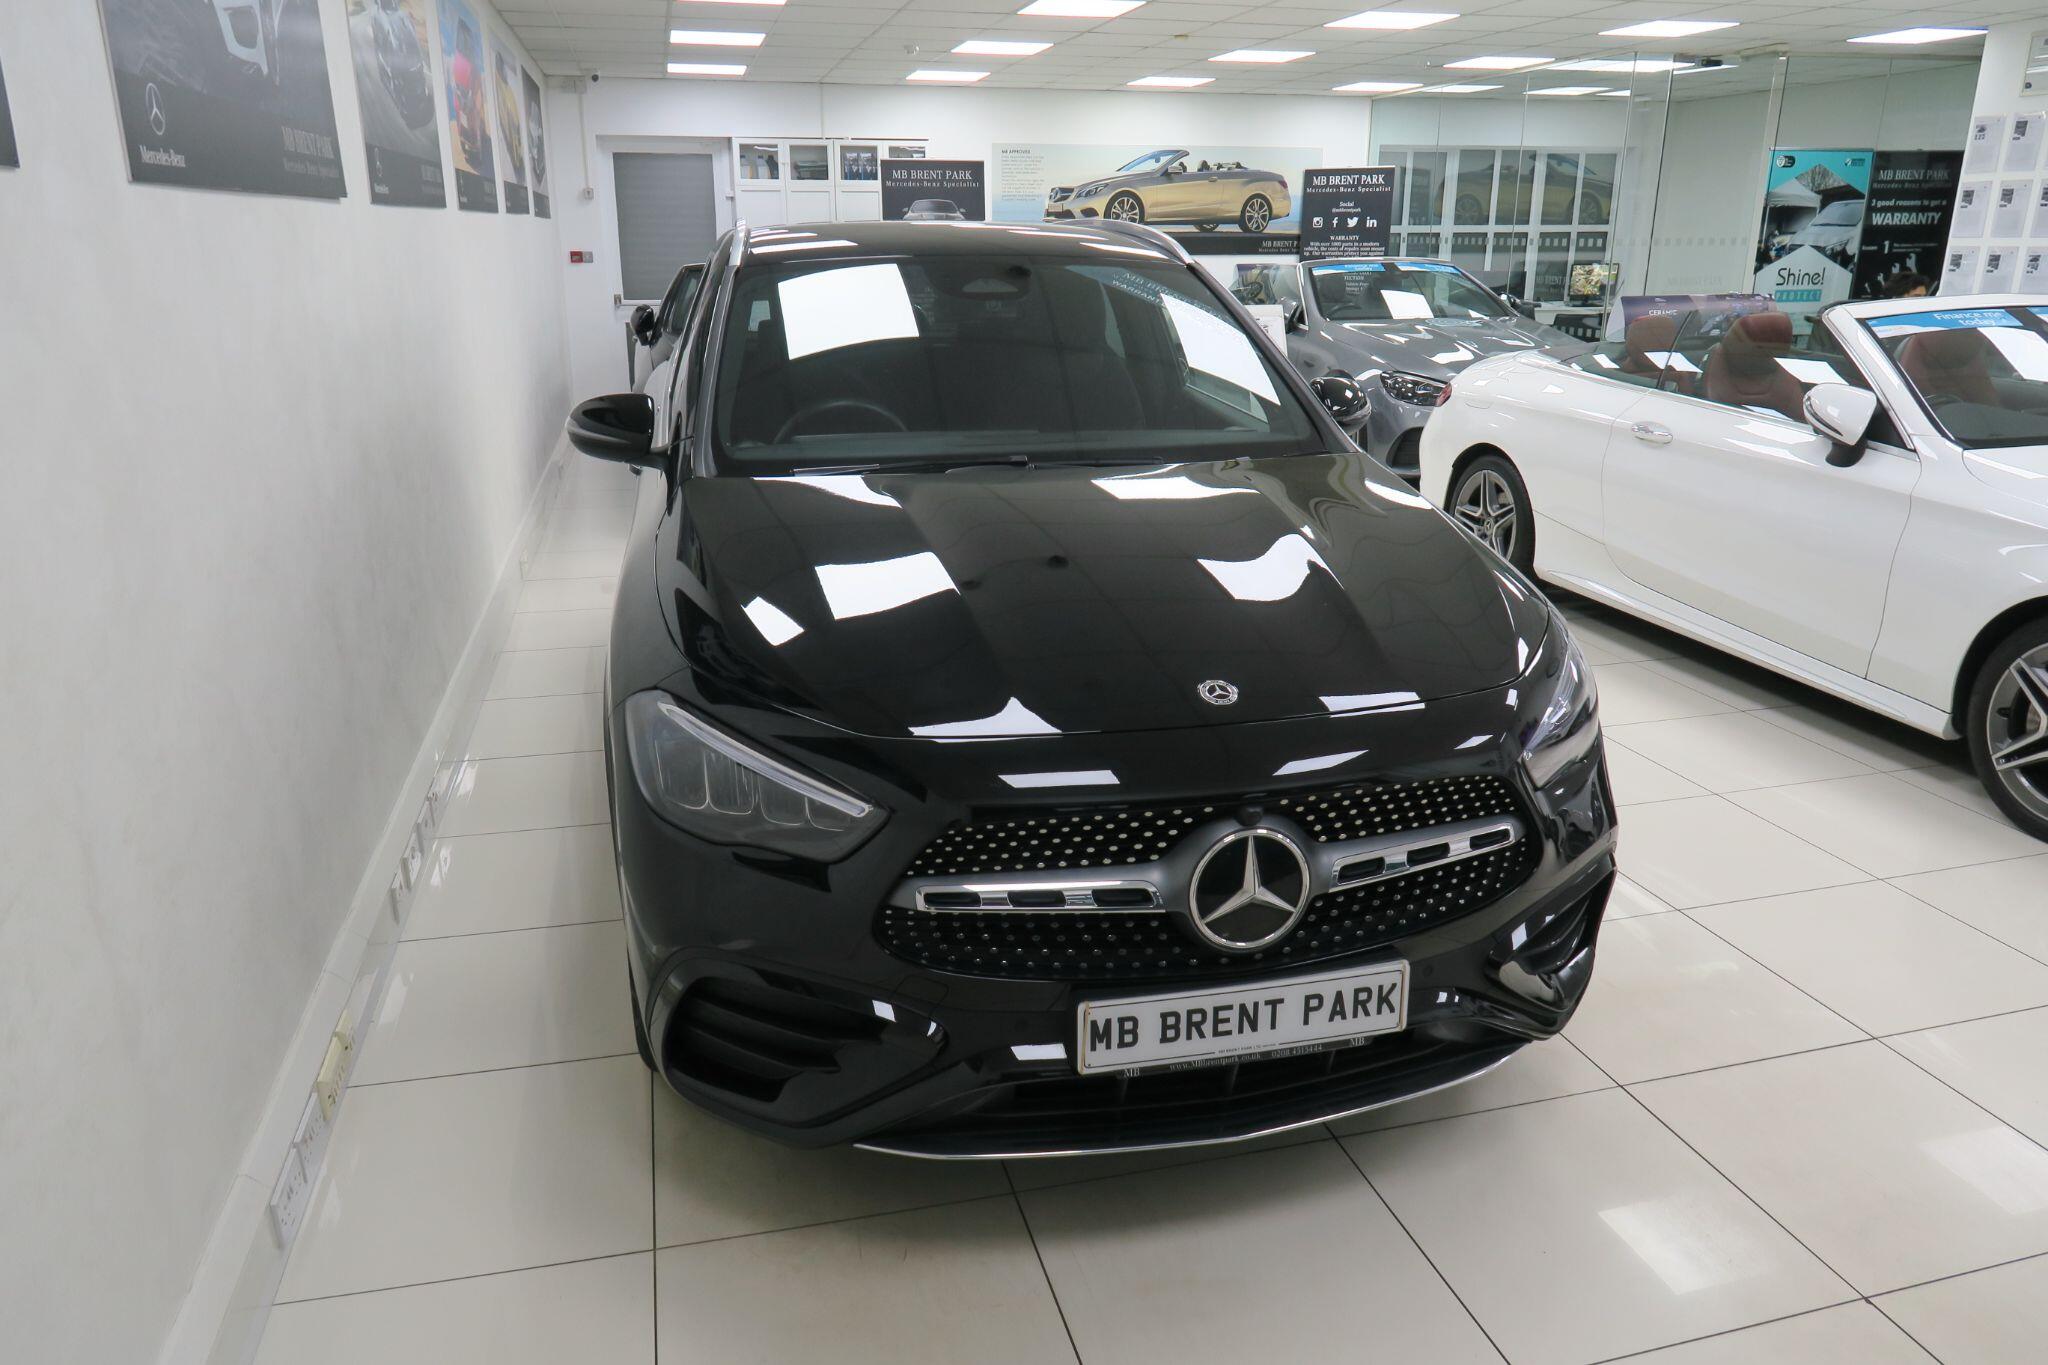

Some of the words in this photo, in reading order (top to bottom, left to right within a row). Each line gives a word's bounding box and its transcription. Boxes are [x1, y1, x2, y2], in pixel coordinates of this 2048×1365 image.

[892, 169, 908, 180] MB
[910, 170, 943, 180] BRENT
[945, 170, 972, 180] PARK
[1312, 176, 1327, 186] MB
[1329, 175, 1360, 185] BRENT
[1361, 174, 1385, 185] PARK
[1879, 169, 1893, 180] MB
[1894, 169, 1926, 180] BRENT
[1926, 169, 1950, 180] PARK
[1358, 185, 1391, 193] Specialist
[1877, 198, 1895, 208] good
[1871, 211, 1942, 226] WARRANTY
[1775, 267, 1826, 287] Shine!
[1777, 290, 1822, 301] PROTECT
[1648, 309, 1678, 317] CERAMIC
[1933, 311, 1980, 321] Finance
[1958, 317, 1997, 327] today
[1089, 1015, 1140, 1052] MB
[1159, 998, 1285, 1044] BRENT
[1302, 982, 1398, 1026] PARK
[1350, 1037, 1365, 1047] MB
[1124, 1067, 1140, 1078] MB
